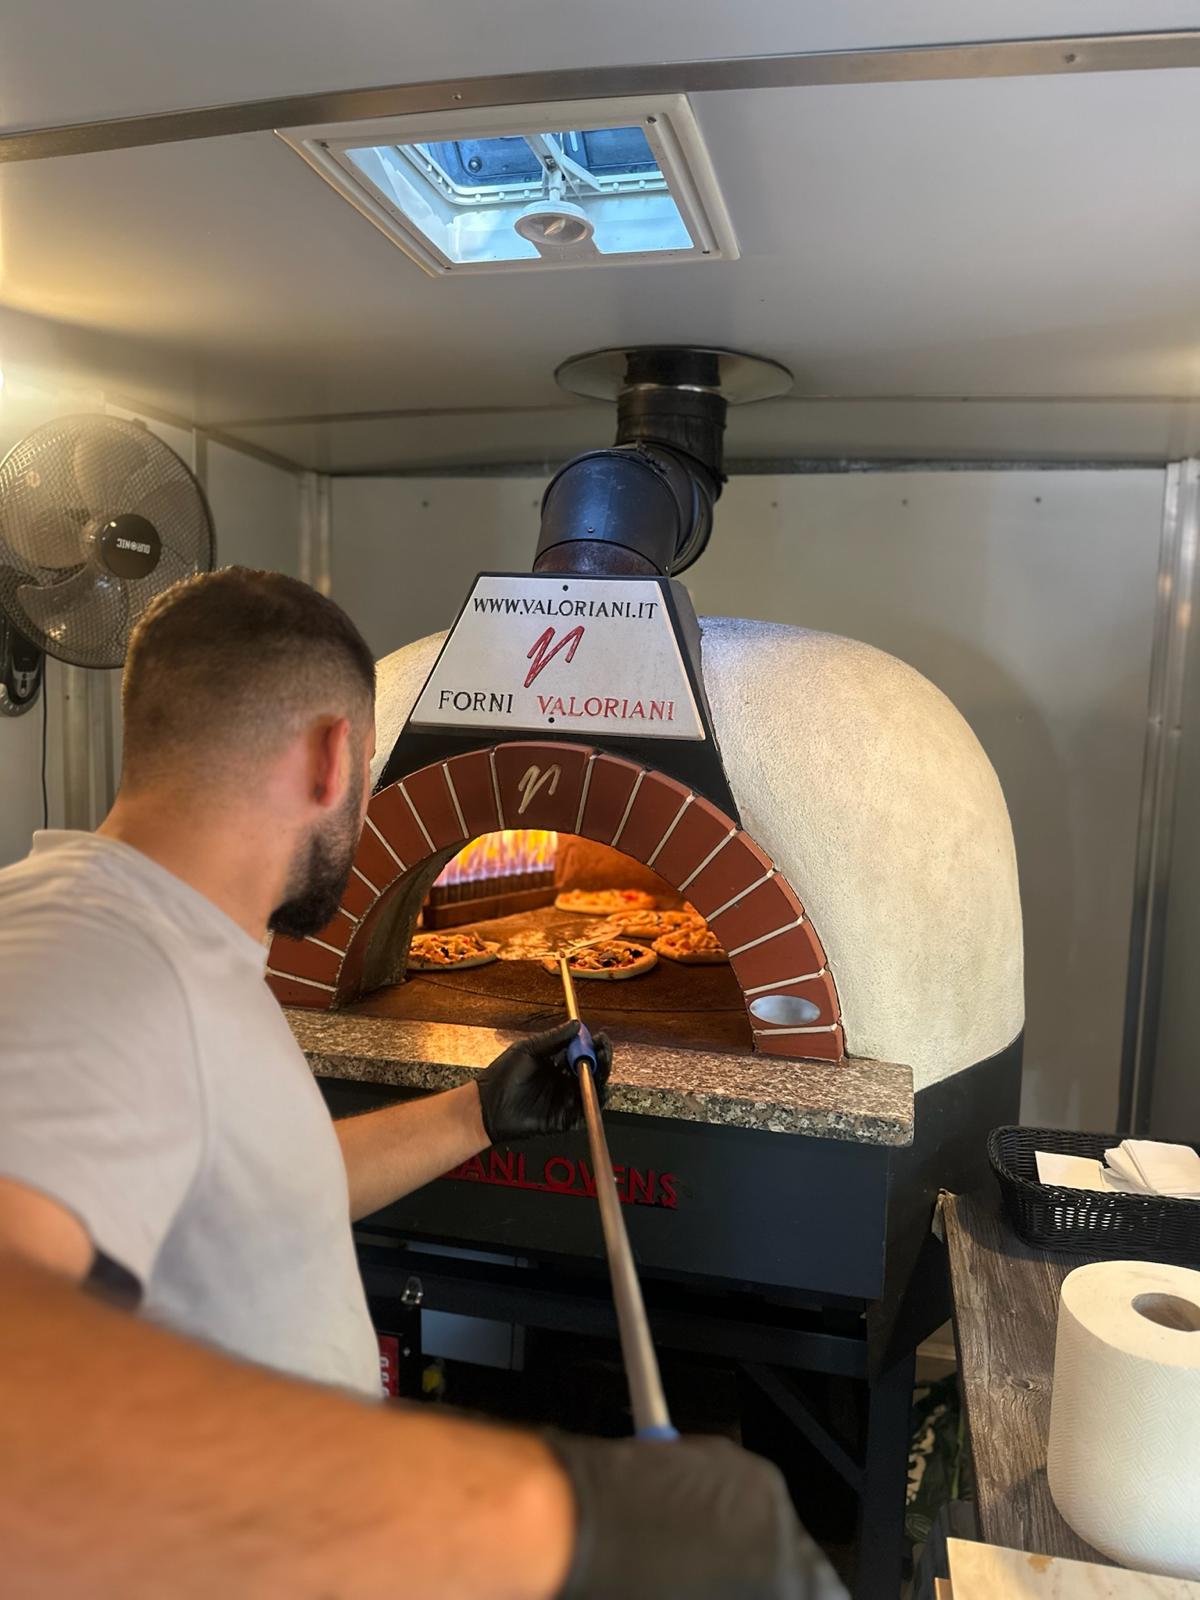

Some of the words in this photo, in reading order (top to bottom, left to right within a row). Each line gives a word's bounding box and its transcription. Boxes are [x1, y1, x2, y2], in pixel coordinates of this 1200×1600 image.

[473, 597, 659, 619] WWW.VALORIANI.IT
[438, 690, 514, 714] FORNI
[537, 695, 675, 721] VALORIANI
[453, 1151, 525, 1188] ANI
